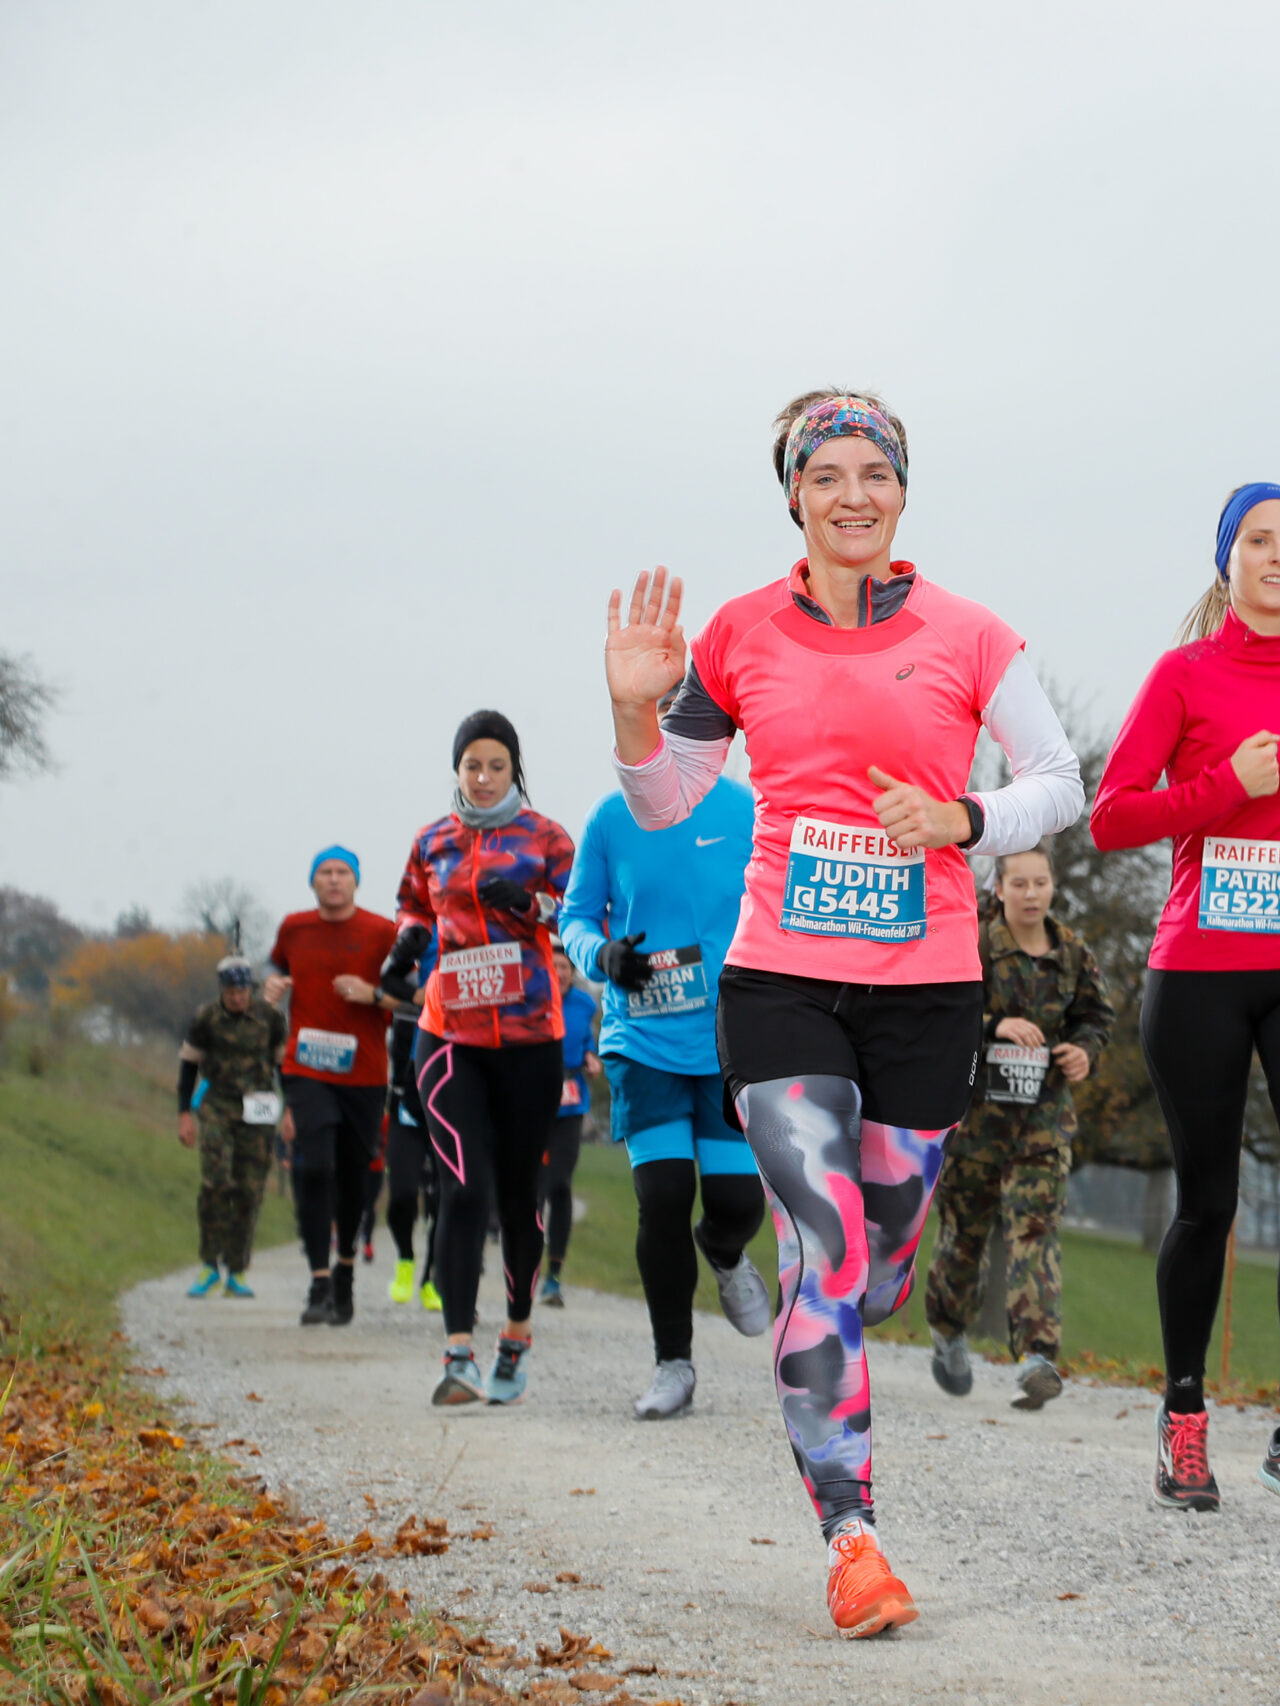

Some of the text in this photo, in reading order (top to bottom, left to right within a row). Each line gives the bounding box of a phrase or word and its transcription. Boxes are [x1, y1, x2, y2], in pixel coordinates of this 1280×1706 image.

[809, 860, 910, 891] JUDITH
[790, 914, 846, 933] Halbmarathon
[848, 922, 906, 938] Wil-Frauenfeld
[457, 965, 504, 984] DARIA
[458, 979, 504, 1000] 2167
